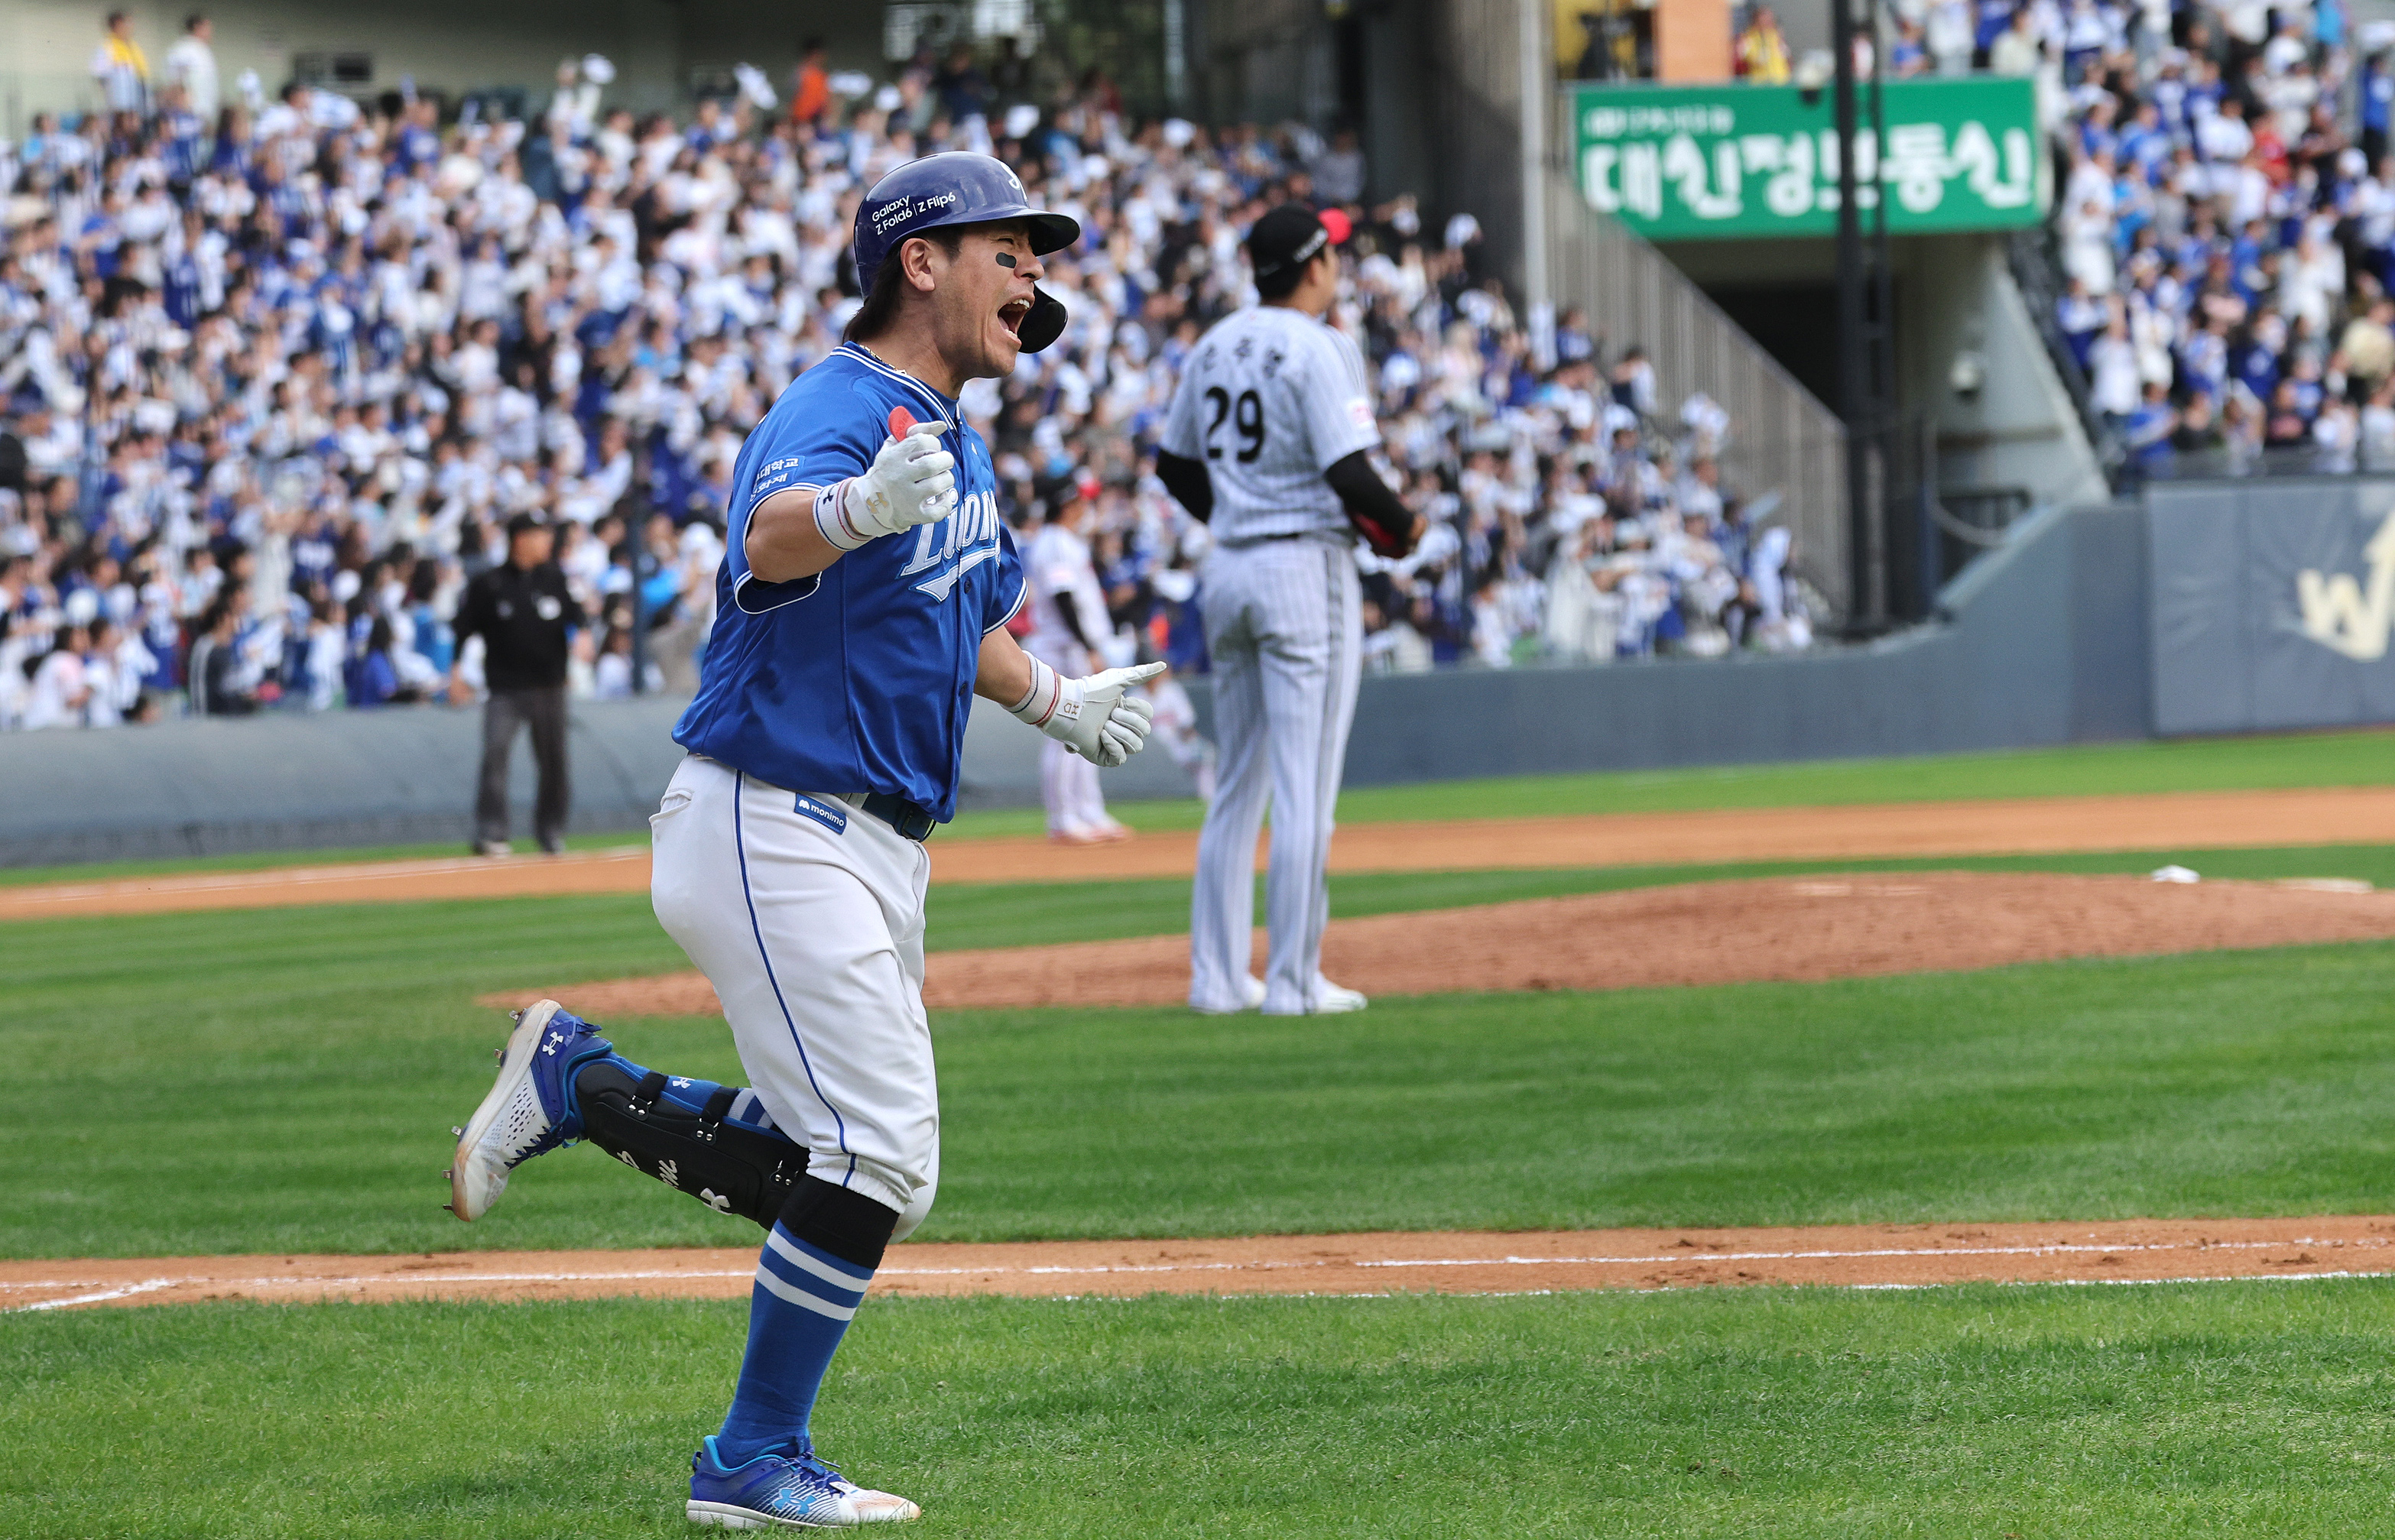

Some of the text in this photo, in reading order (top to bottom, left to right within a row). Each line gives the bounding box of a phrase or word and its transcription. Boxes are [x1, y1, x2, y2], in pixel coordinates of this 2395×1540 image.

[872, 195, 910, 222] Galaxy
[875, 192, 956, 235] Z Fold6 Z Flip6
[1205, 386, 1264, 464] 29
[810, 804, 845, 827] monimo
